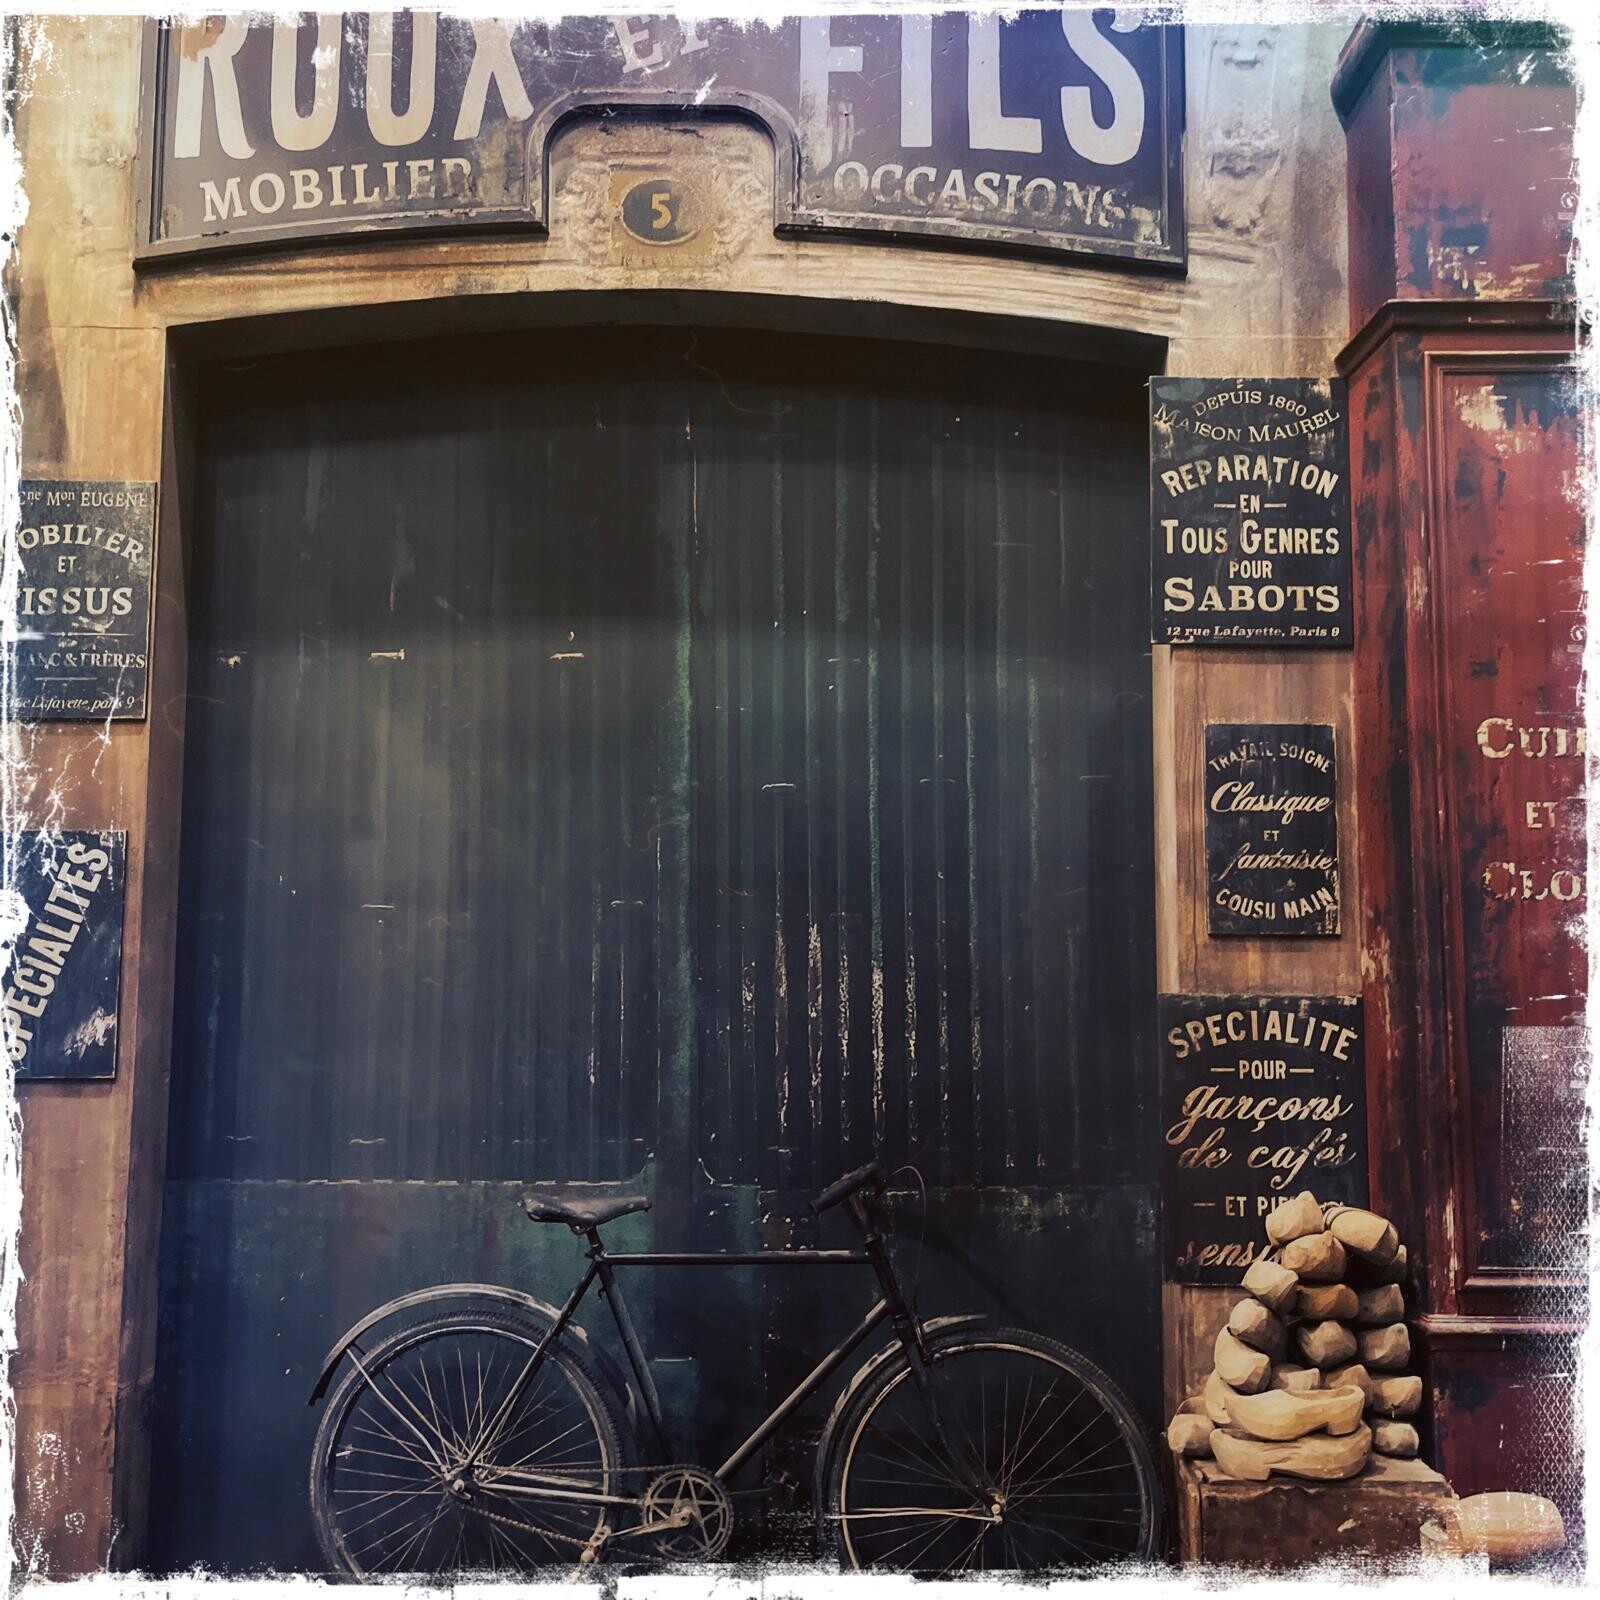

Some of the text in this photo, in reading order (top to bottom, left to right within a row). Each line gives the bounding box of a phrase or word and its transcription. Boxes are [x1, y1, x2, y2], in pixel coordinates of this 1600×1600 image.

[173, 13, 534, 160] ROUX
[799, 10, 1146, 170] FILS
[201, 158, 473, 222] MOBILIER
[833, 161, 1130, 228] OCCASIONS
[651, 193, 673, 230] 5
[1192, 390, 1263, 417] DEPUIS
[1153, 402, 1341, 443] MAISON MAUREL
[1160, 454, 1339, 499] REPARATION
[1239, 494, 1261, 514] EN
[57, 555, 78, 573] ET
[1229, 559, 1273, 579] POUR
[16, 587, 134, 616] ISSUS
[1163, 576, 1340, 613] SABOTS
[1165, 626, 1182, 637] 12
[1184, 629, 1211, 637] rue
[1289, 626, 1328, 637] Paris
[1208, 741, 1274, 773] TRAVAIL
[1210, 780, 1333, 825] Classique
[1526, 802, 1558, 828] ET
[1263, 830, 1280, 843] ET
[1215, 887, 1335, 921] COUSU MAIN
[1238, 1059, 1287, 1080] POUR
[1165, 1084, 1354, 1146] garçons
[1177, 1126, 1233, 1170] de
[1225, 1196, 1248, 1217] ET
